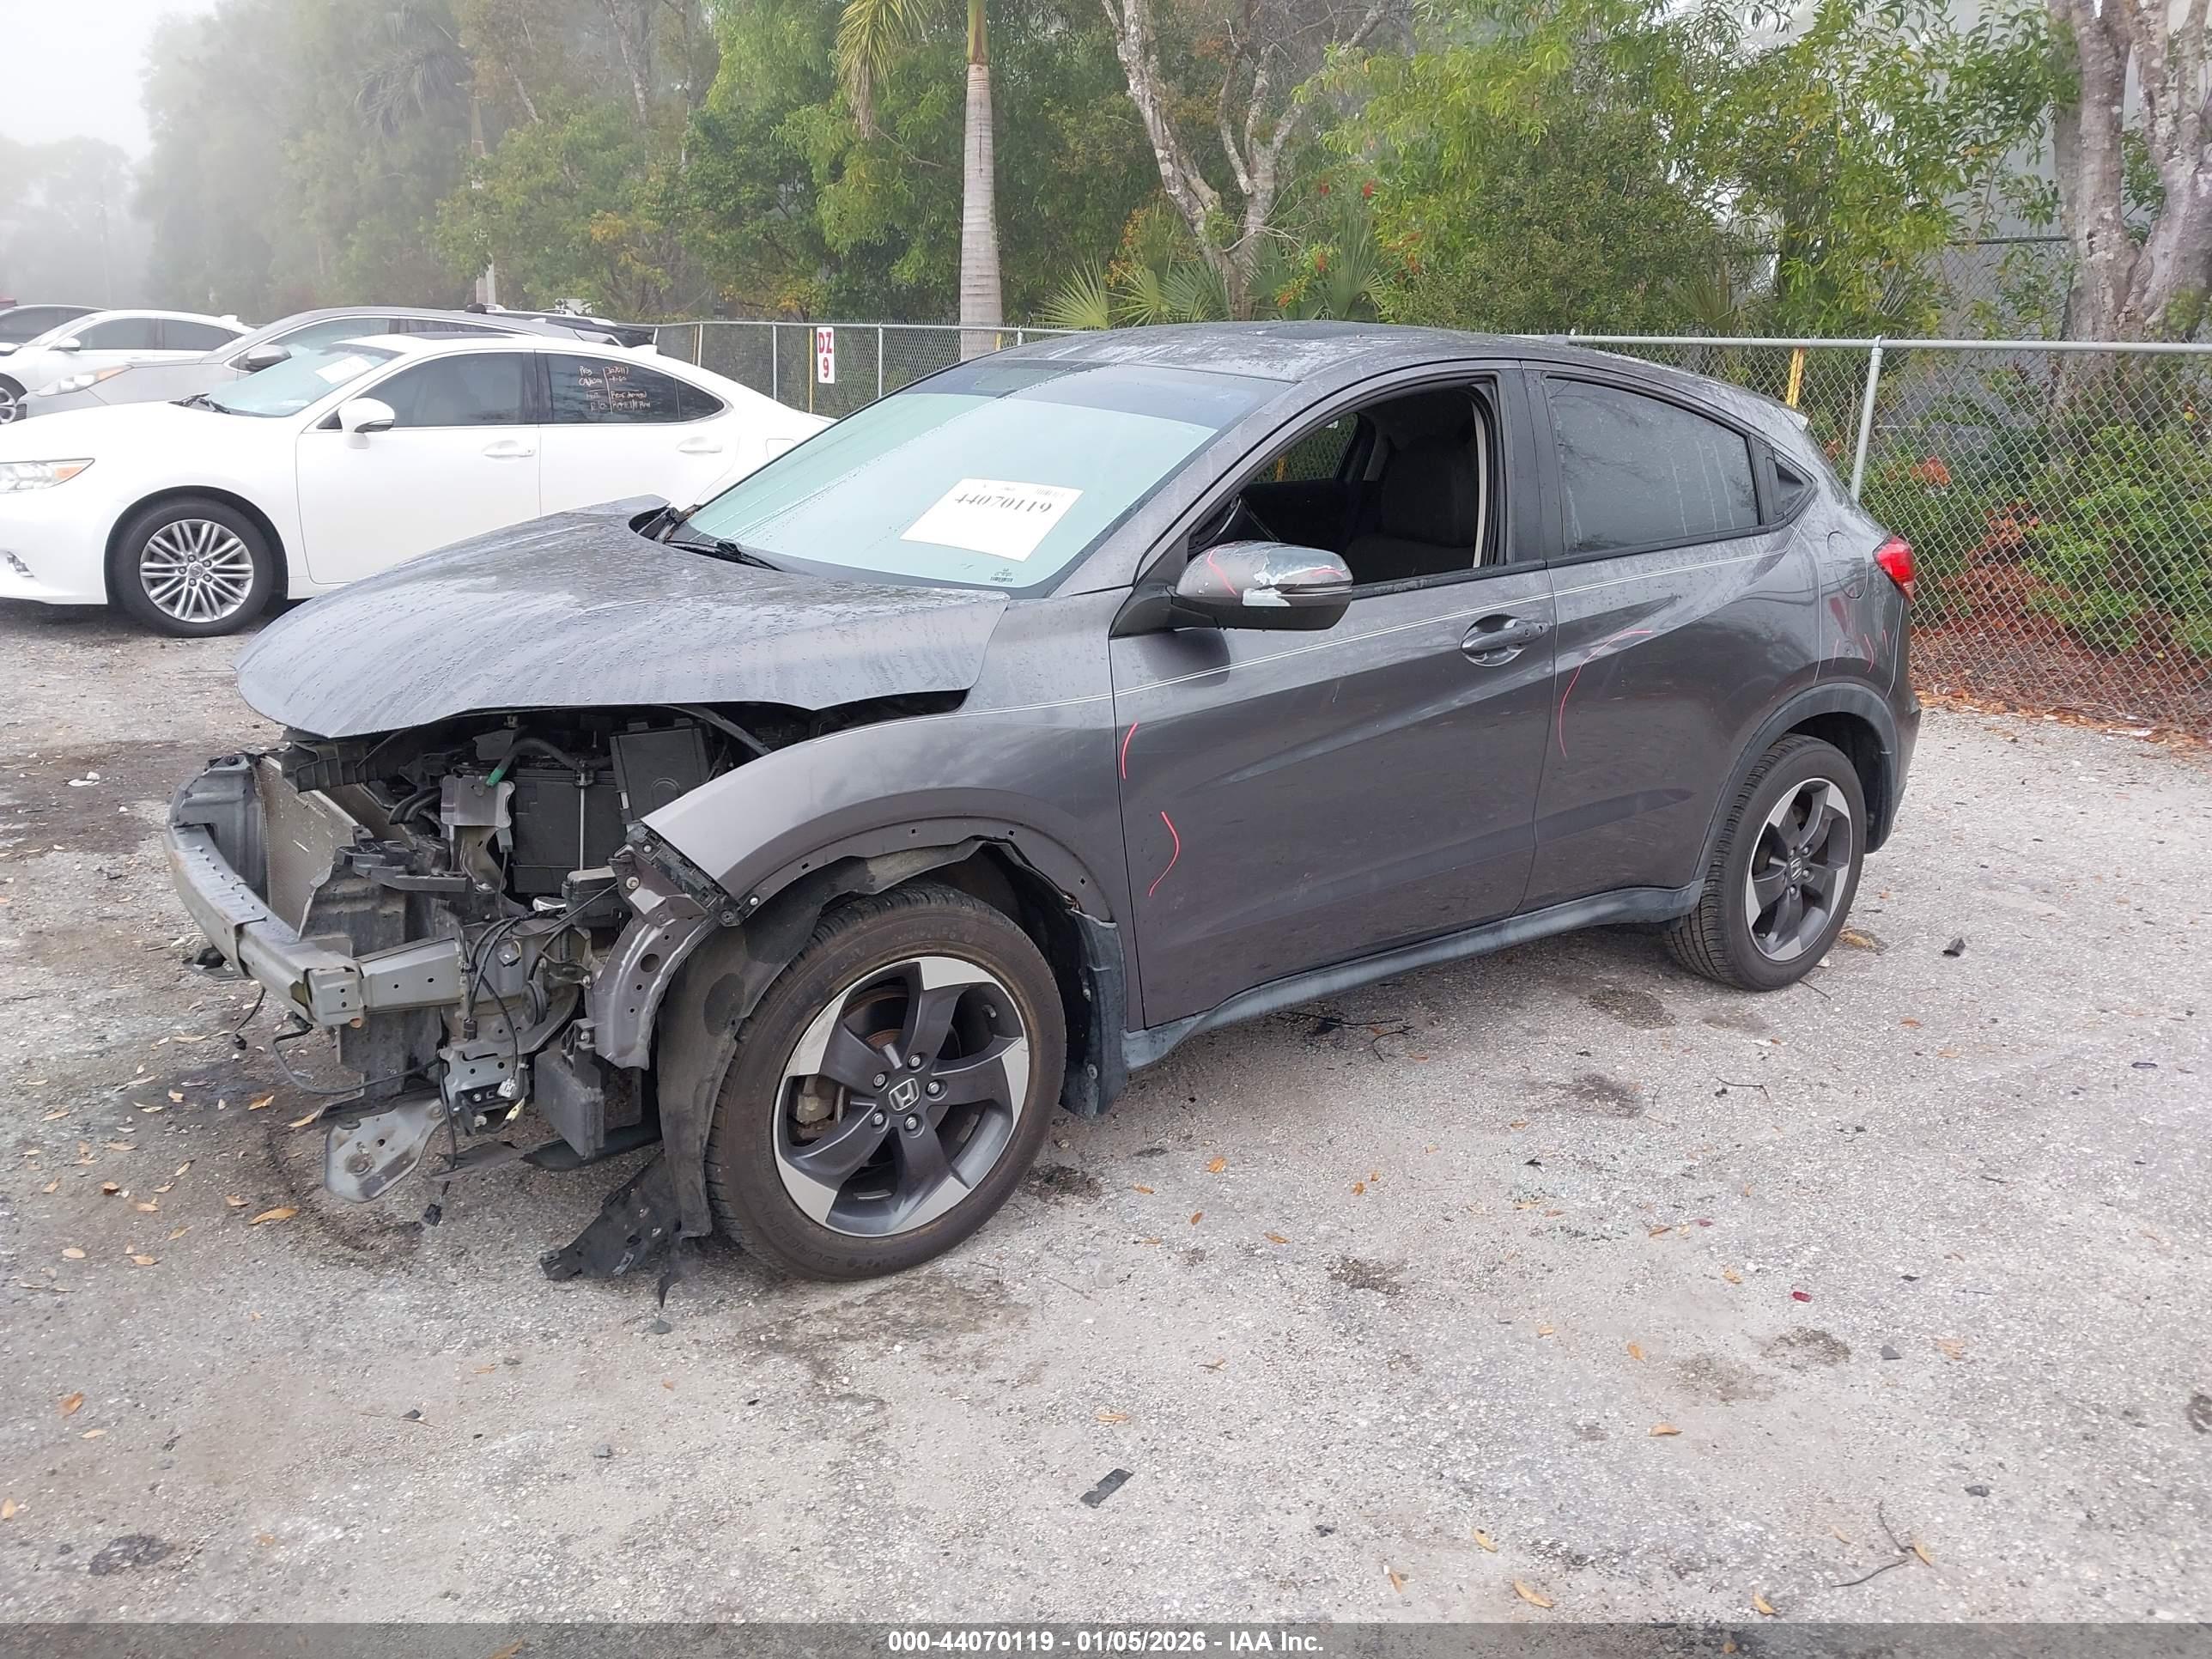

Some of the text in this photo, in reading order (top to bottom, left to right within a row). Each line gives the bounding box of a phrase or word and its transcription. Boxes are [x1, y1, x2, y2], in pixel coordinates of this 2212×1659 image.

[818, 332, 832, 354] DZ
[823, 356, 830, 378] 9
[955, 493, 1052, 513] 44070119
